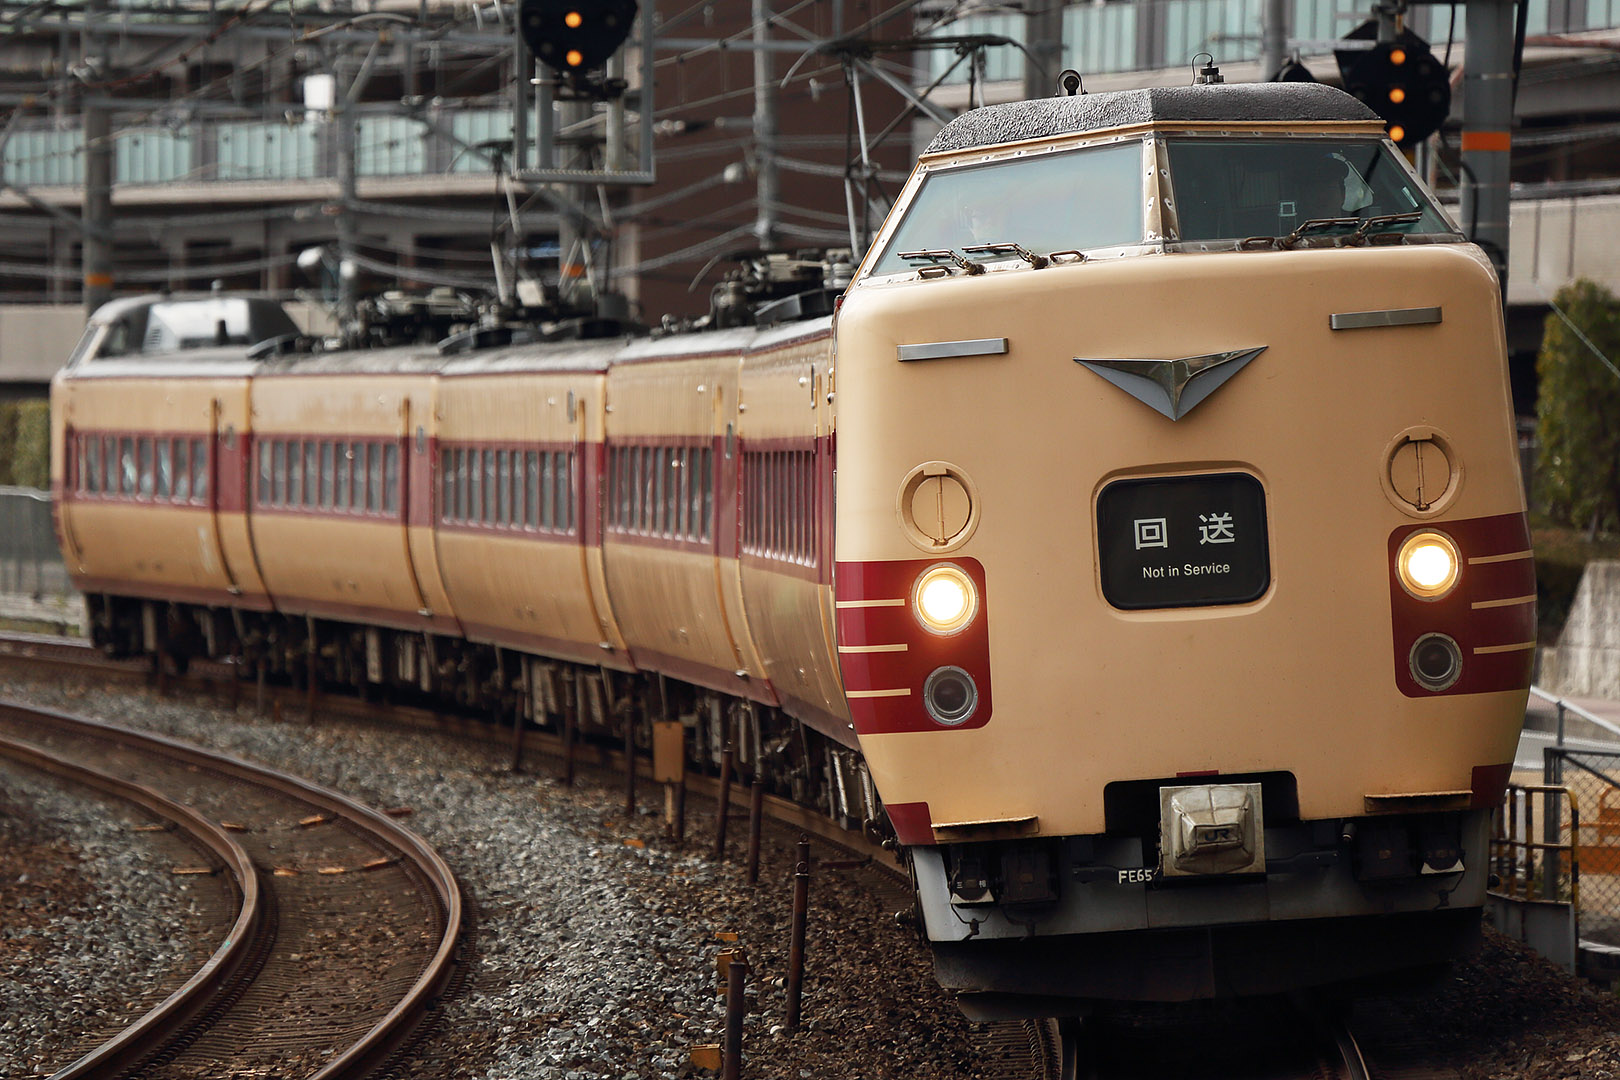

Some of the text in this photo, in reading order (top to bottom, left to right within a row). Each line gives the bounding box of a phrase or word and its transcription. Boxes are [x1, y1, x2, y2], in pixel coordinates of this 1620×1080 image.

[1133, 512, 1236, 550] 回送
[1142, 562, 1231, 579] Not in Service
[1204, 828, 1230, 842] JR
[1118, 869, 1153, 884] FE65
